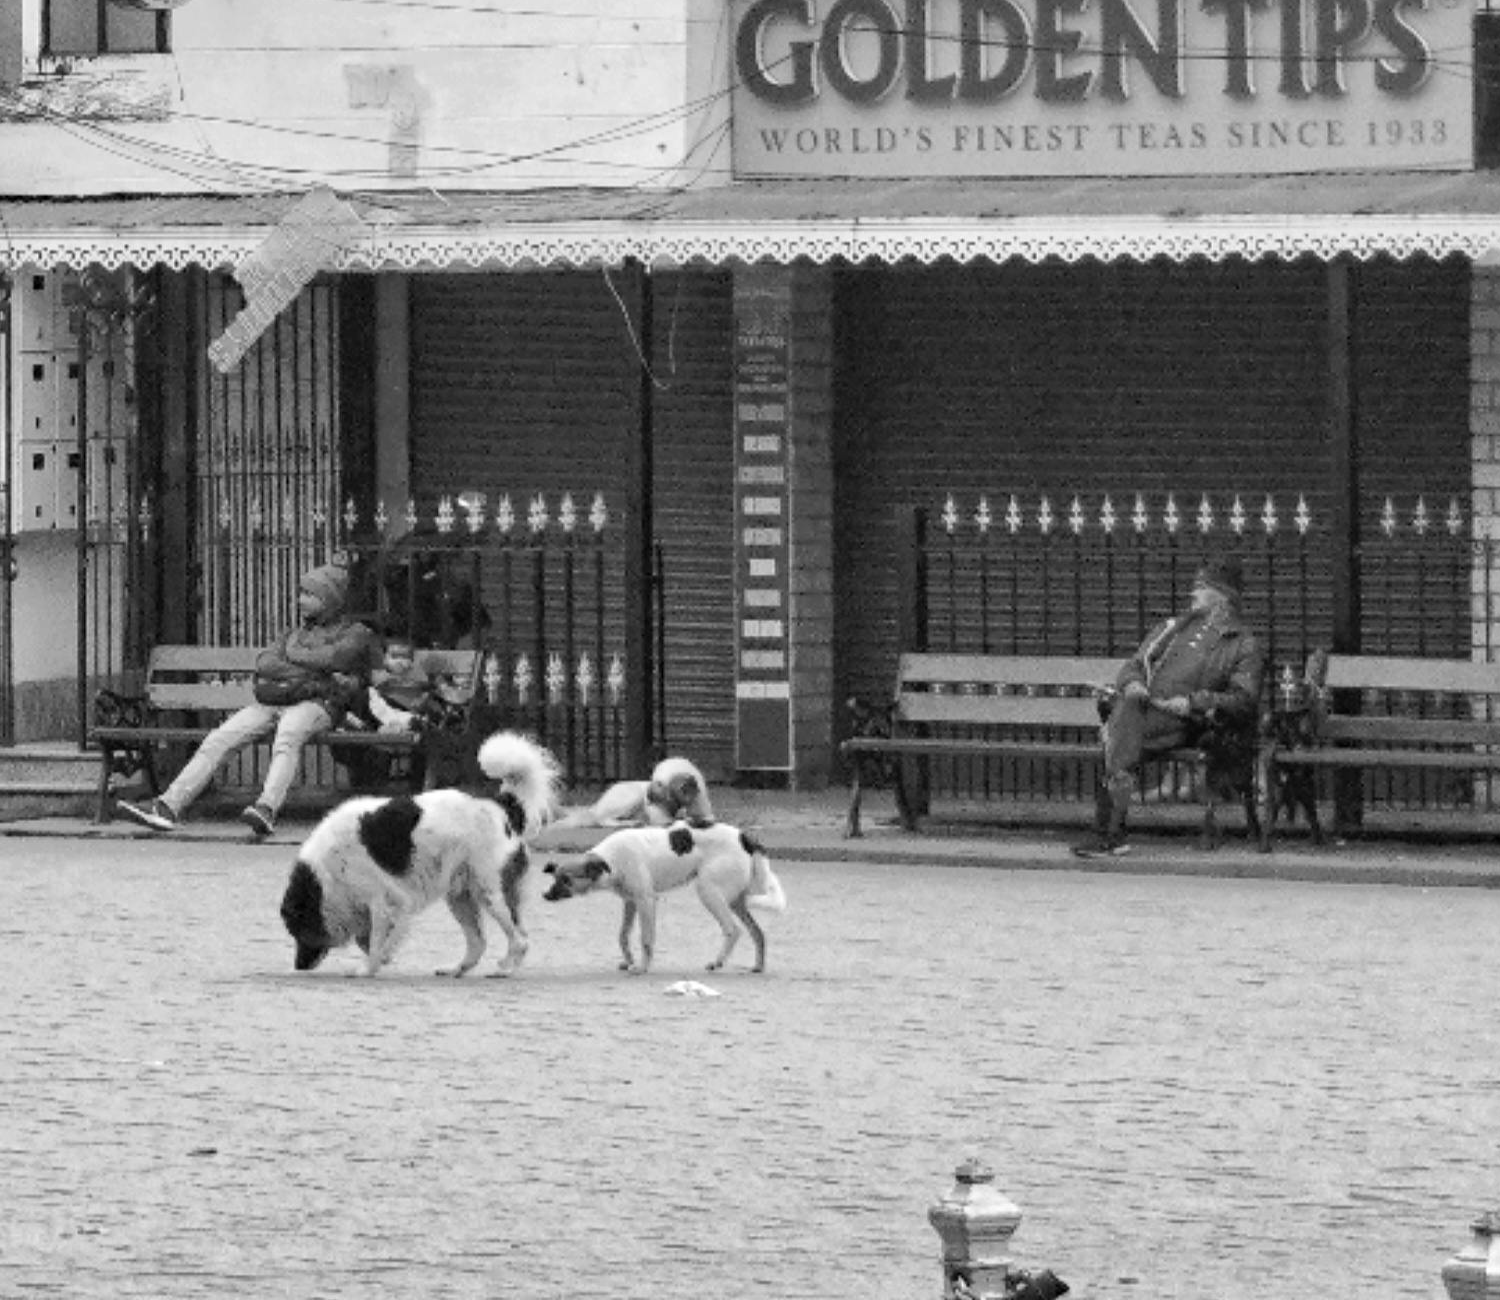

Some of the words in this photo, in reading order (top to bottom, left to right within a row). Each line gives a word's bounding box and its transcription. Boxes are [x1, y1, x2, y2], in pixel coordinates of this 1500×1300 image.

[759, 125, 934, 156] WORLD'S
[952, 123, 1088, 153] FINEST
[1110, 122, 1209, 151] TEAS
[1226, 121, 1346, 149] SINCE
[1366, 118, 1450, 147] 1933
